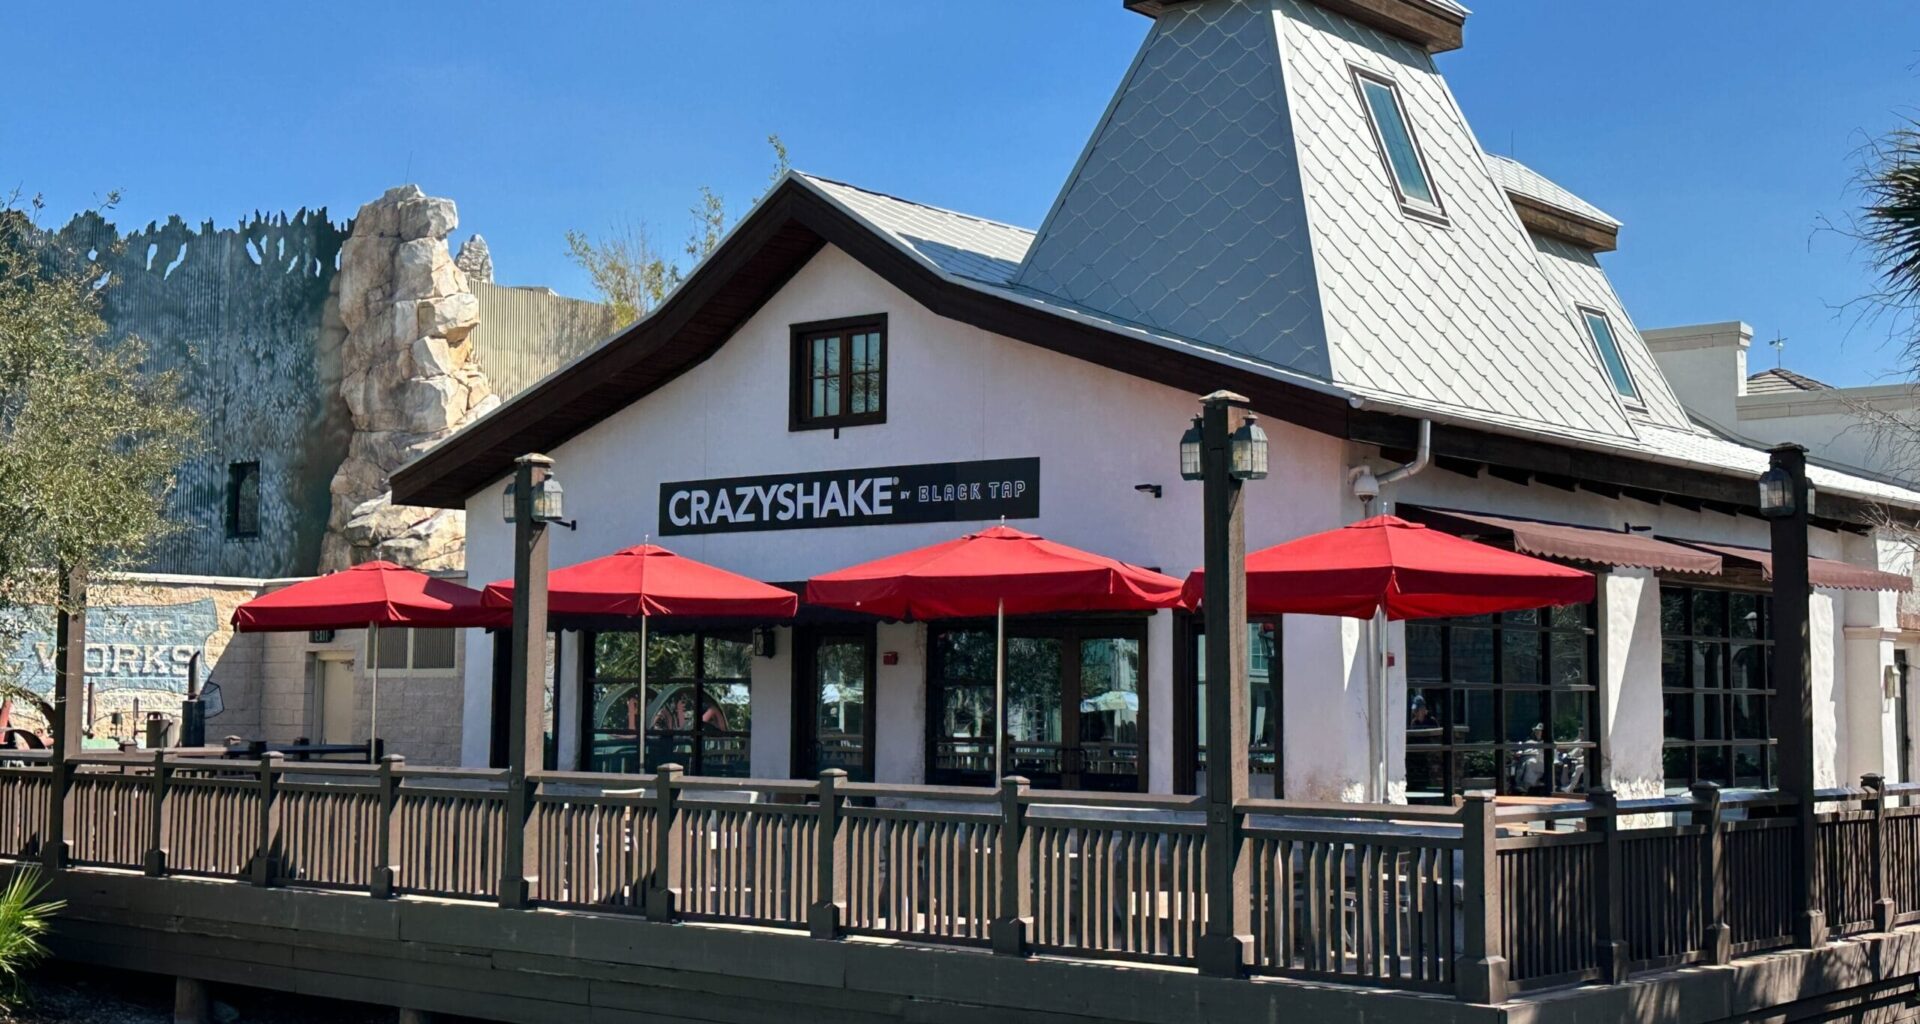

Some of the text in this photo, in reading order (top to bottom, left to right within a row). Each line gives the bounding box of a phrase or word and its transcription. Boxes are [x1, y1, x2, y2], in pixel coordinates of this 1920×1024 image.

[900, 490, 911, 500] BY
[918, 482, 981, 502] BLACK
[988, 480, 1026, 499] TAP
